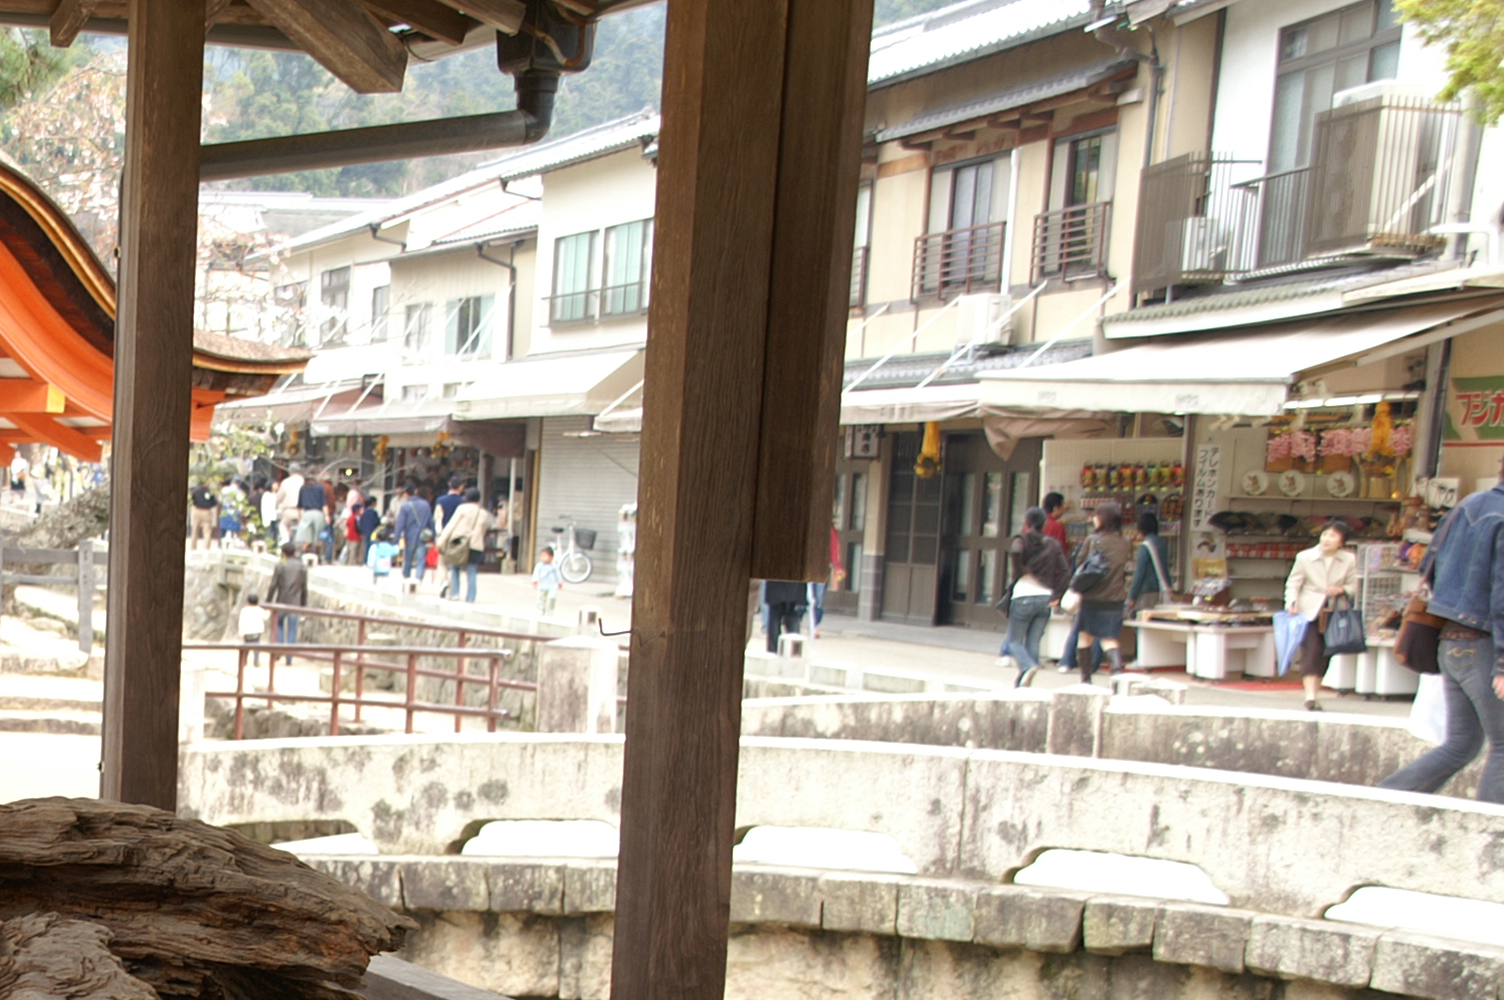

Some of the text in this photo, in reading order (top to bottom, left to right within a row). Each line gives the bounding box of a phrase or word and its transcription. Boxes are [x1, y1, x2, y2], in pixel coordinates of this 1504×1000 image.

[1204, 447, 1219, 518] テレホンカード
